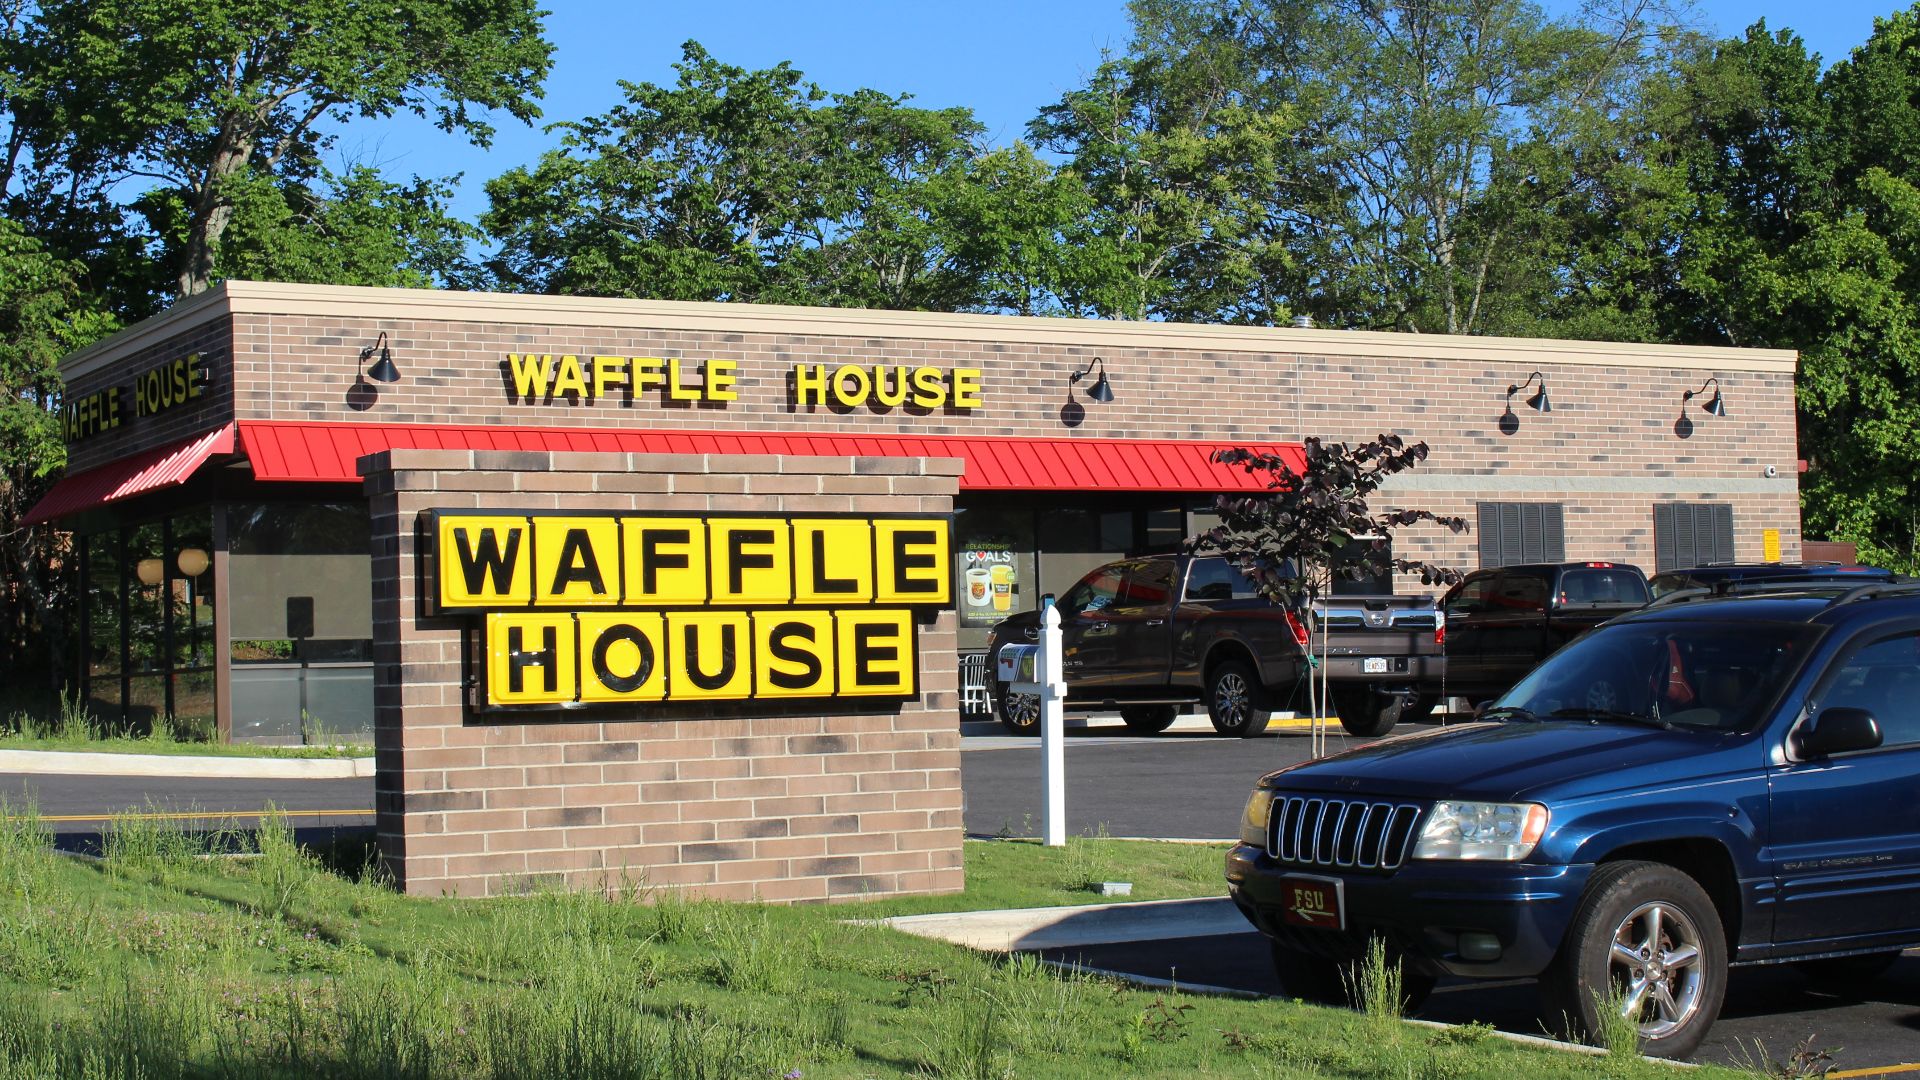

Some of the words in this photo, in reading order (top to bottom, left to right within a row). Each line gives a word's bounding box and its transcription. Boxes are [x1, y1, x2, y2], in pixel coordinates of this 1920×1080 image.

[135, 353, 200, 418] HOUSE
[507, 353, 739, 402] WAFFLE
[793, 363, 983, 408] HOUSE
[453, 526, 940, 596] WAFFLE
[507, 622, 900, 693] HOUSE
[1294, 888, 1324, 911] FSU
